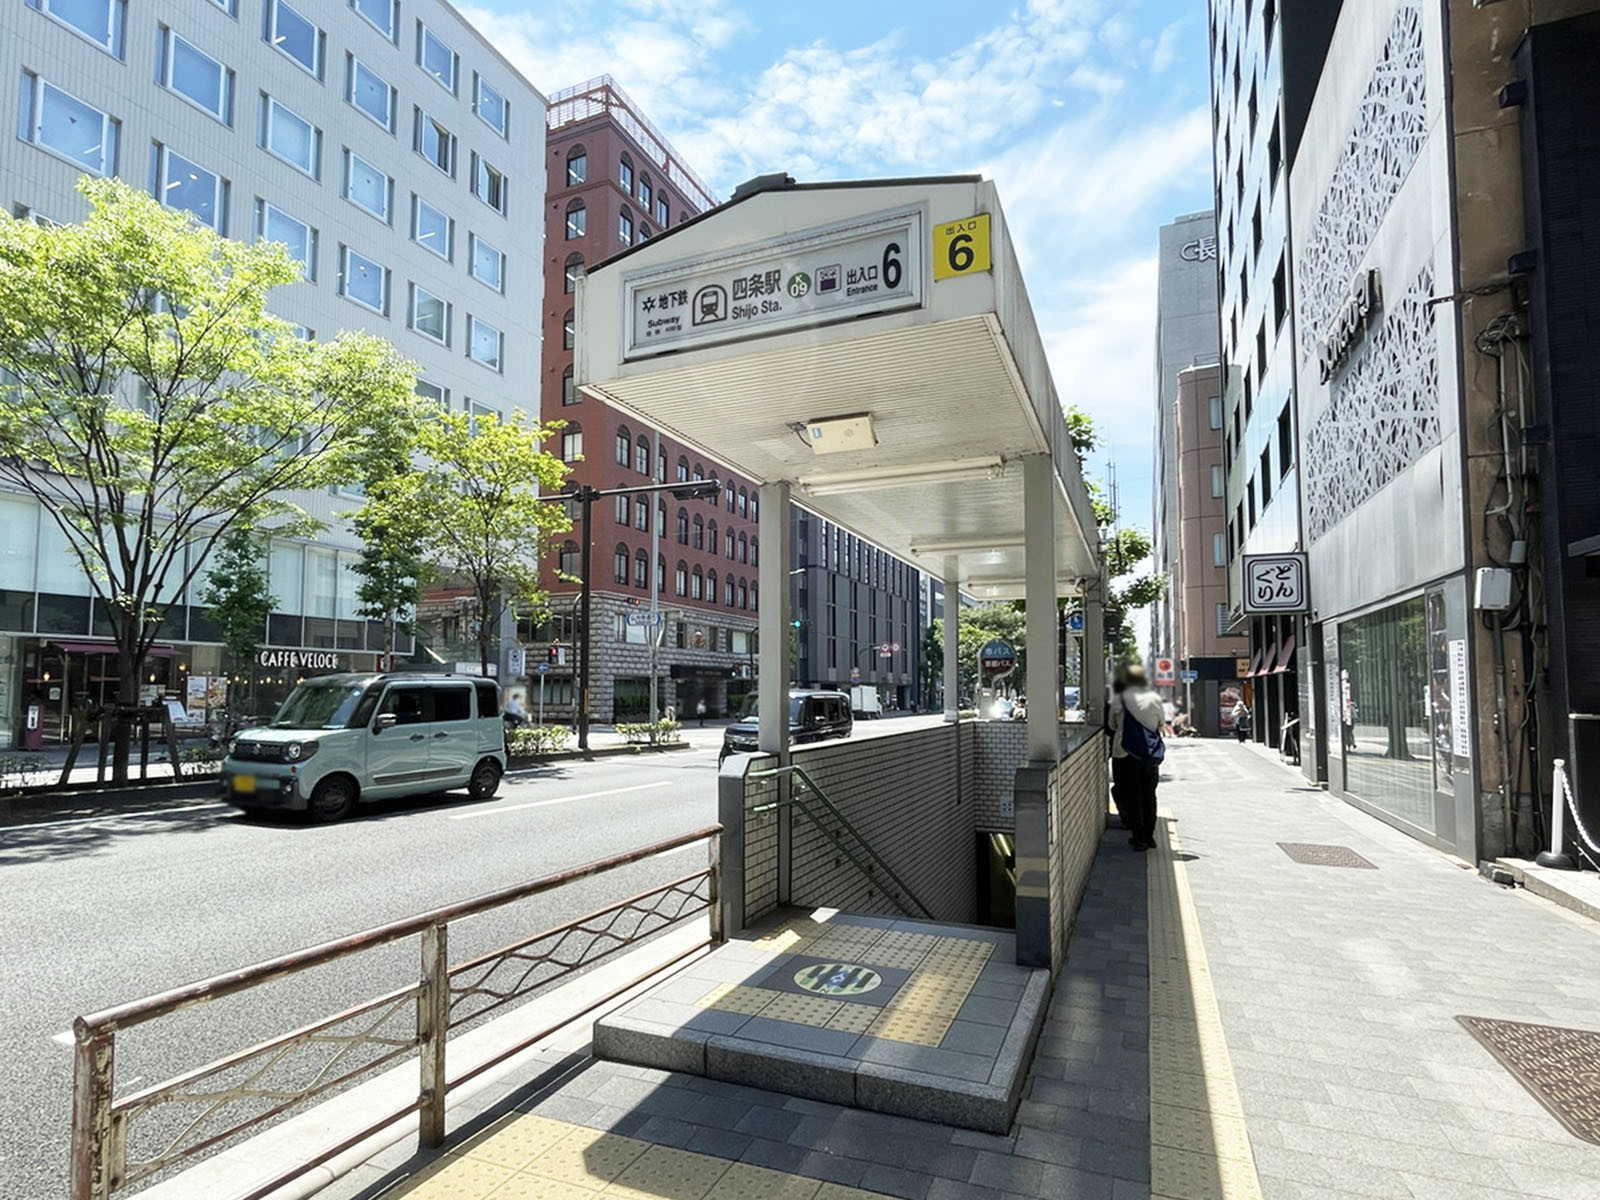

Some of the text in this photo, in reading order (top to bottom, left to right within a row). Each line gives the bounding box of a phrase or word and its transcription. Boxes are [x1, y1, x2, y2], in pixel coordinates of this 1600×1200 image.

[945, 220, 977, 236] 出入口
[948, 234, 975, 272] 6
[846, 265, 878, 286] 出入口
[882, 243, 902, 289] 6
[732, 269, 782, 301] 四条駅
[790, 282, 808, 298] 09
[846, 282, 878, 297] Entrance
[657, 289, 689, 311] 地下鉄
[732, 299, 782, 321] Shijo Sta.
[647, 315, 681, 329] Subway
[260, 650, 338, 669] CAFFE VELOCE
